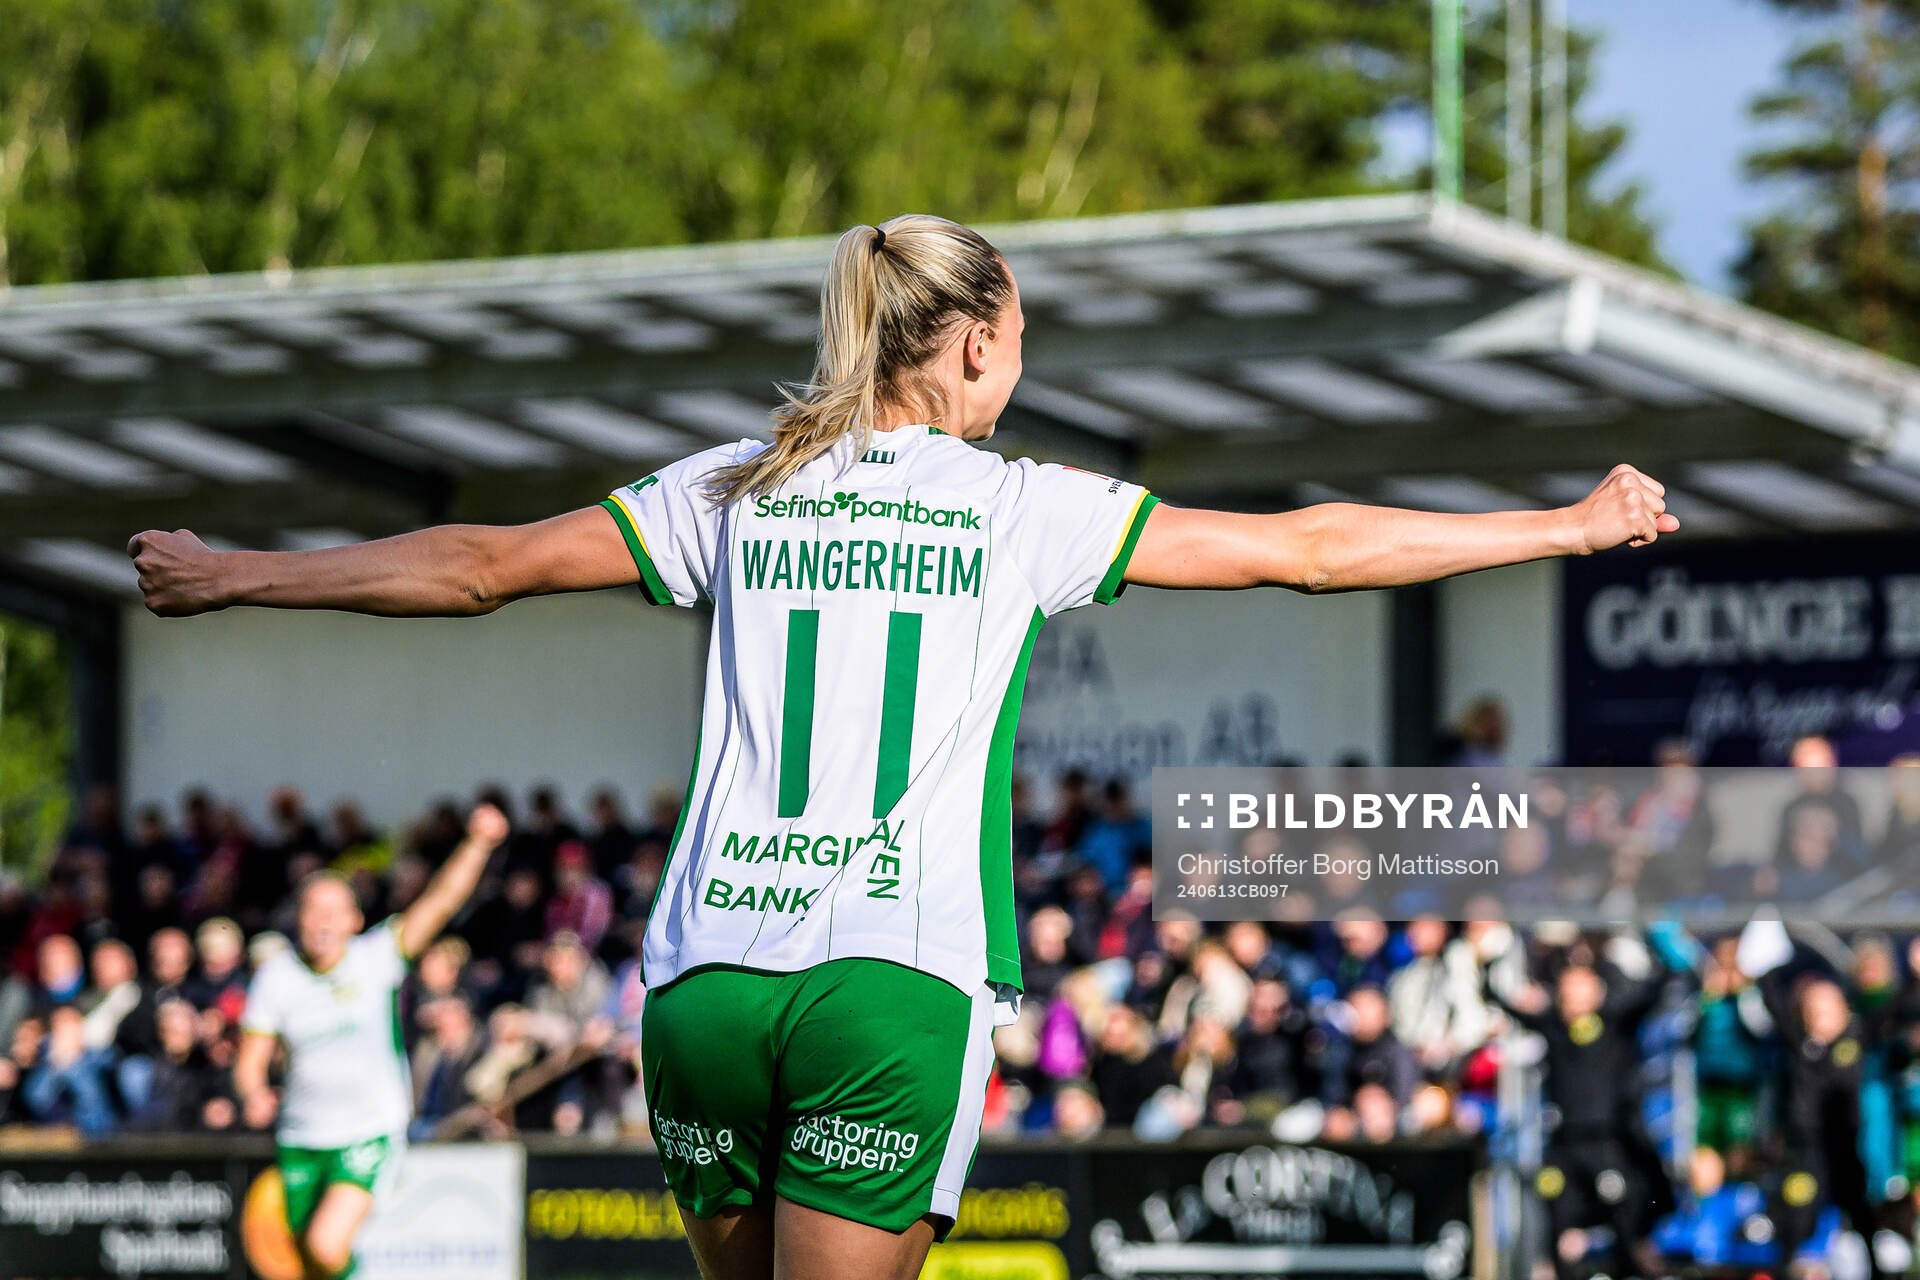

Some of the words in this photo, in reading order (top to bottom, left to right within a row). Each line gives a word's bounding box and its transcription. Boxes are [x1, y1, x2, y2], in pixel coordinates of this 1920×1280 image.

[754, 494, 836, 518] Sefina
[850, 499, 982, 530] pantbank
[742, 539, 983, 598] WANGERHEIM
[777, 608, 923, 819] 11
[703, 878, 821, 914] BANK
